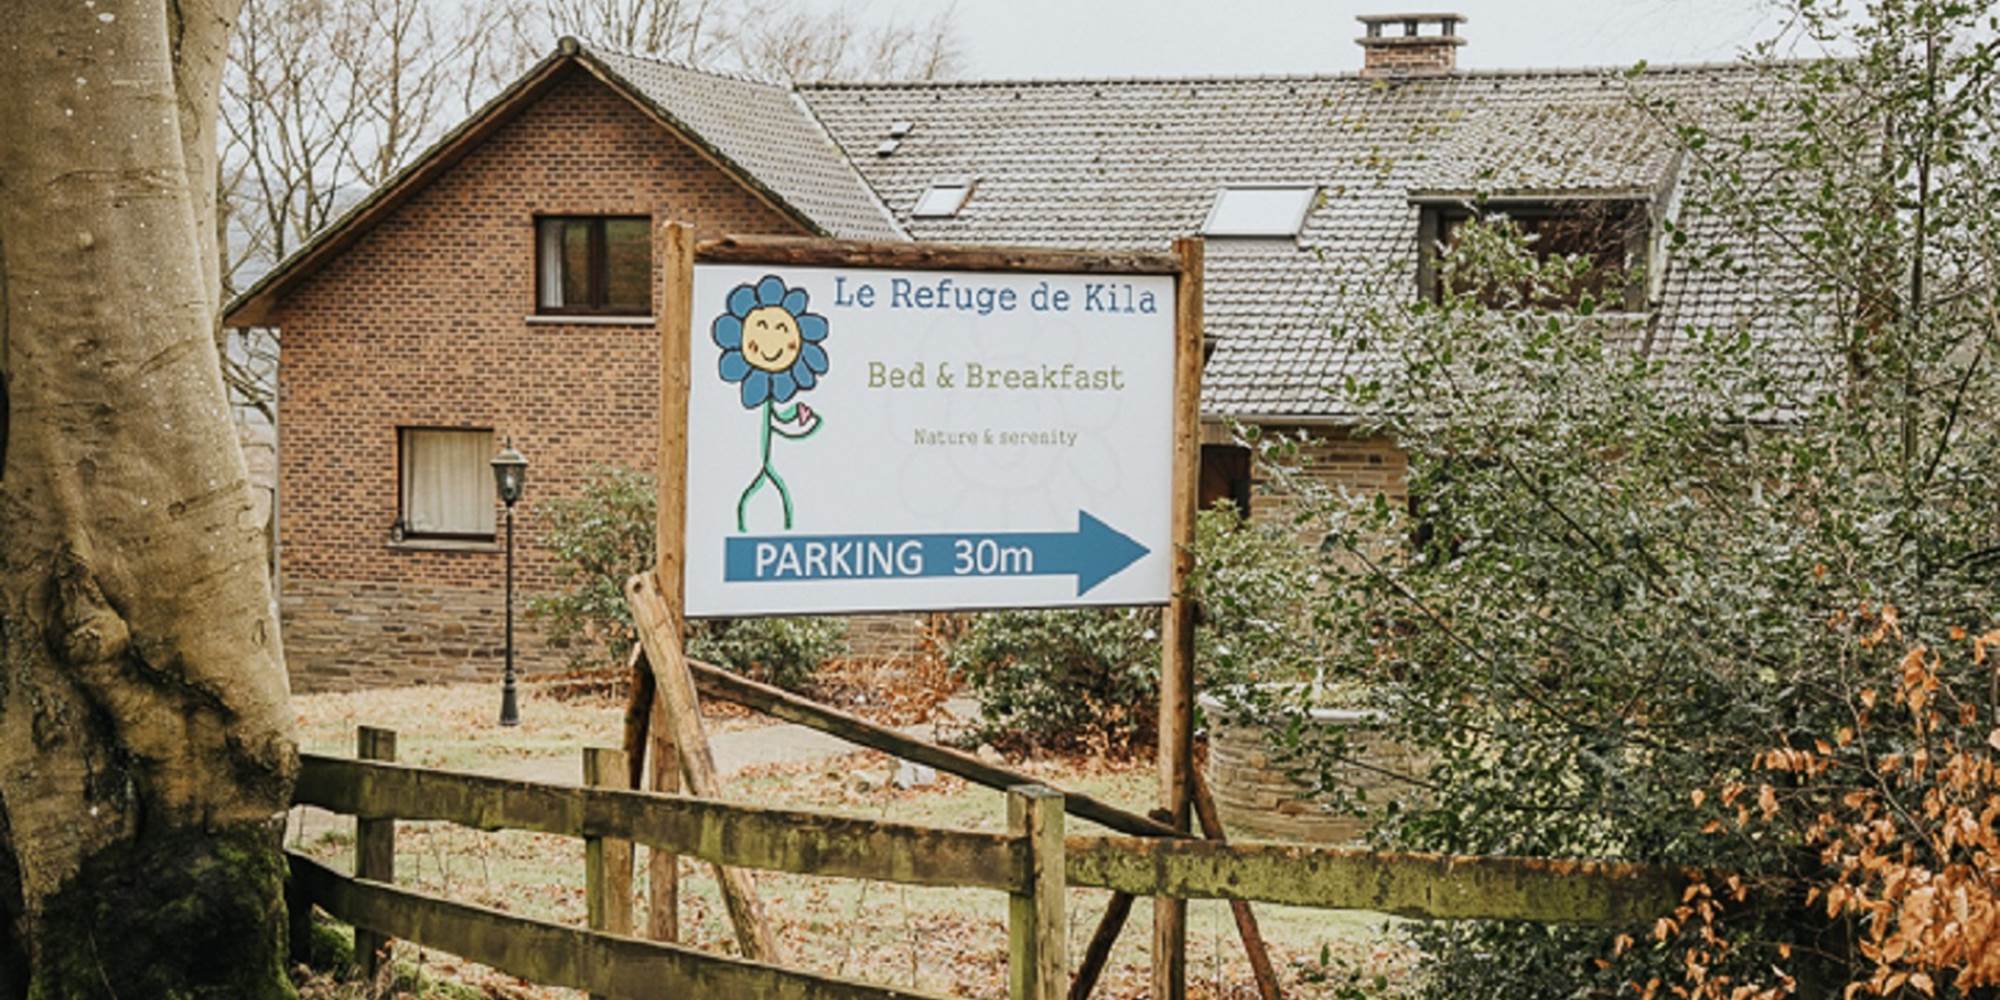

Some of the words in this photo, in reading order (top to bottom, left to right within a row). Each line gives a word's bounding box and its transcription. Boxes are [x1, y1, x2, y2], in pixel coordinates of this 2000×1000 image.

[834, 276, 875, 309] Le
[891, 278, 1017, 315] Refuge
[1030, 281, 1070, 312] de
[1085, 283, 1157, 314] Kila
[867, 361, 926, 389] Bed
[936, 361, 955, 389] &
[965, 362, 1125, 391] Breakfast
[913, 428, 978, 446] Nature
[983, 428, 994, 445] &
[999, 429, 1078, 448] serenity
[754, 540, 924, 577] PARKING
[953, 539, 1034, 576] 30m
